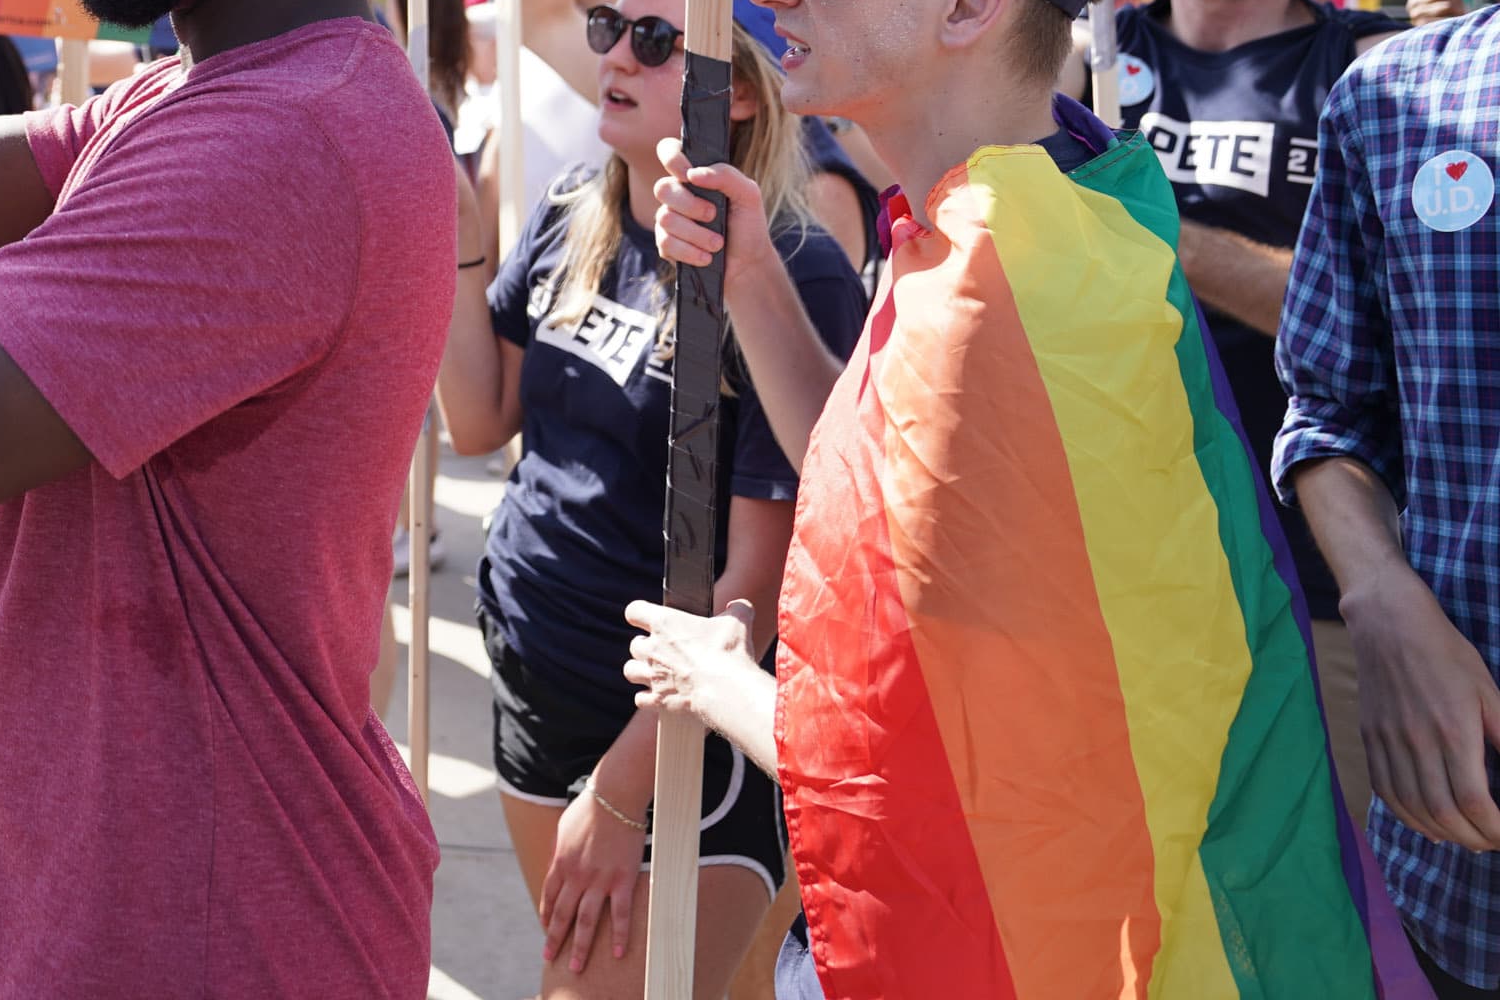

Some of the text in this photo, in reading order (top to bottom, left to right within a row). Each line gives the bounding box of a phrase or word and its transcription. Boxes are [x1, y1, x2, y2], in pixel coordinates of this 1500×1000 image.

[1433, 163, 1441, 186] I
[1425, 185, 1480, 217] J.D.
[562, 304, 645, 366] ETE
